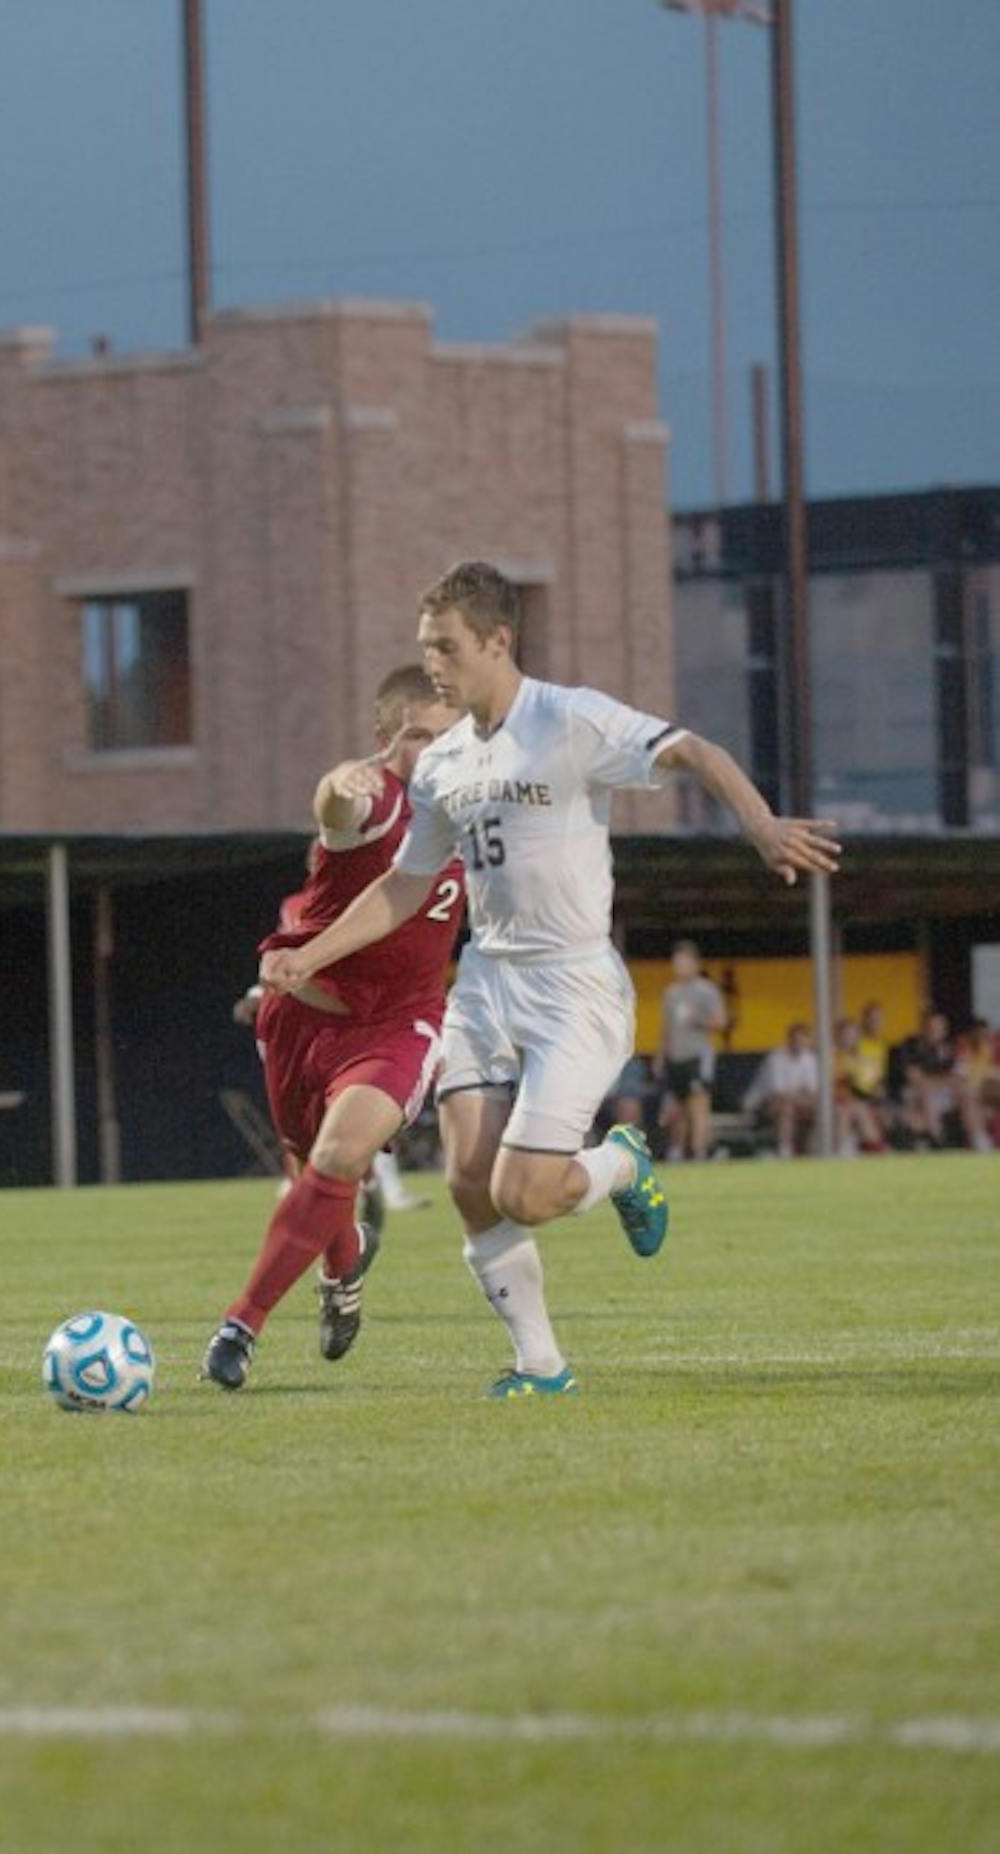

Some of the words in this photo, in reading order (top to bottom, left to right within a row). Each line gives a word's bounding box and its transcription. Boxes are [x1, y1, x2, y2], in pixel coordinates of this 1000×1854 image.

[488, 779, 552, 806] DAME
[469, 817, 505, 870] 15
[427, 879, 459, 922] 2
